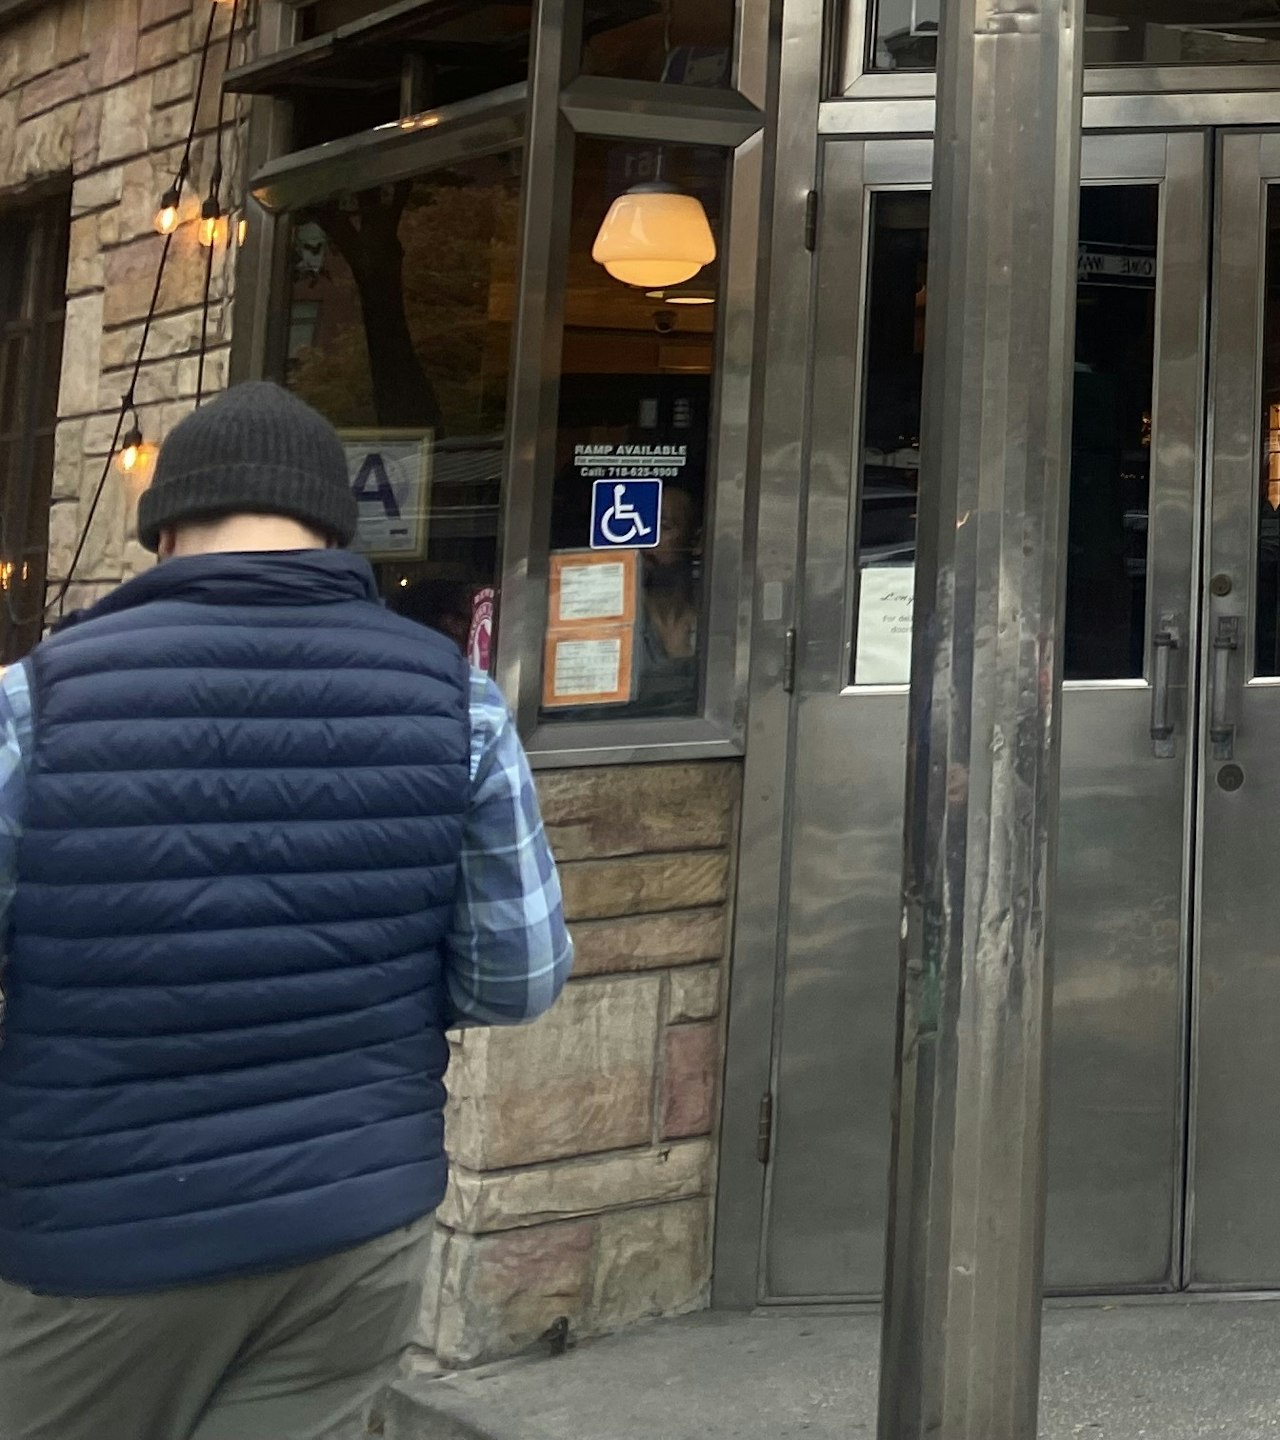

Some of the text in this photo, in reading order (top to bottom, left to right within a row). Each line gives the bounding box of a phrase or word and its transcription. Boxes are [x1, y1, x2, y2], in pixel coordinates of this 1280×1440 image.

[574, 444, 688, 456] RAMP AVAILABLE
[352, 453, 400, 517] A
